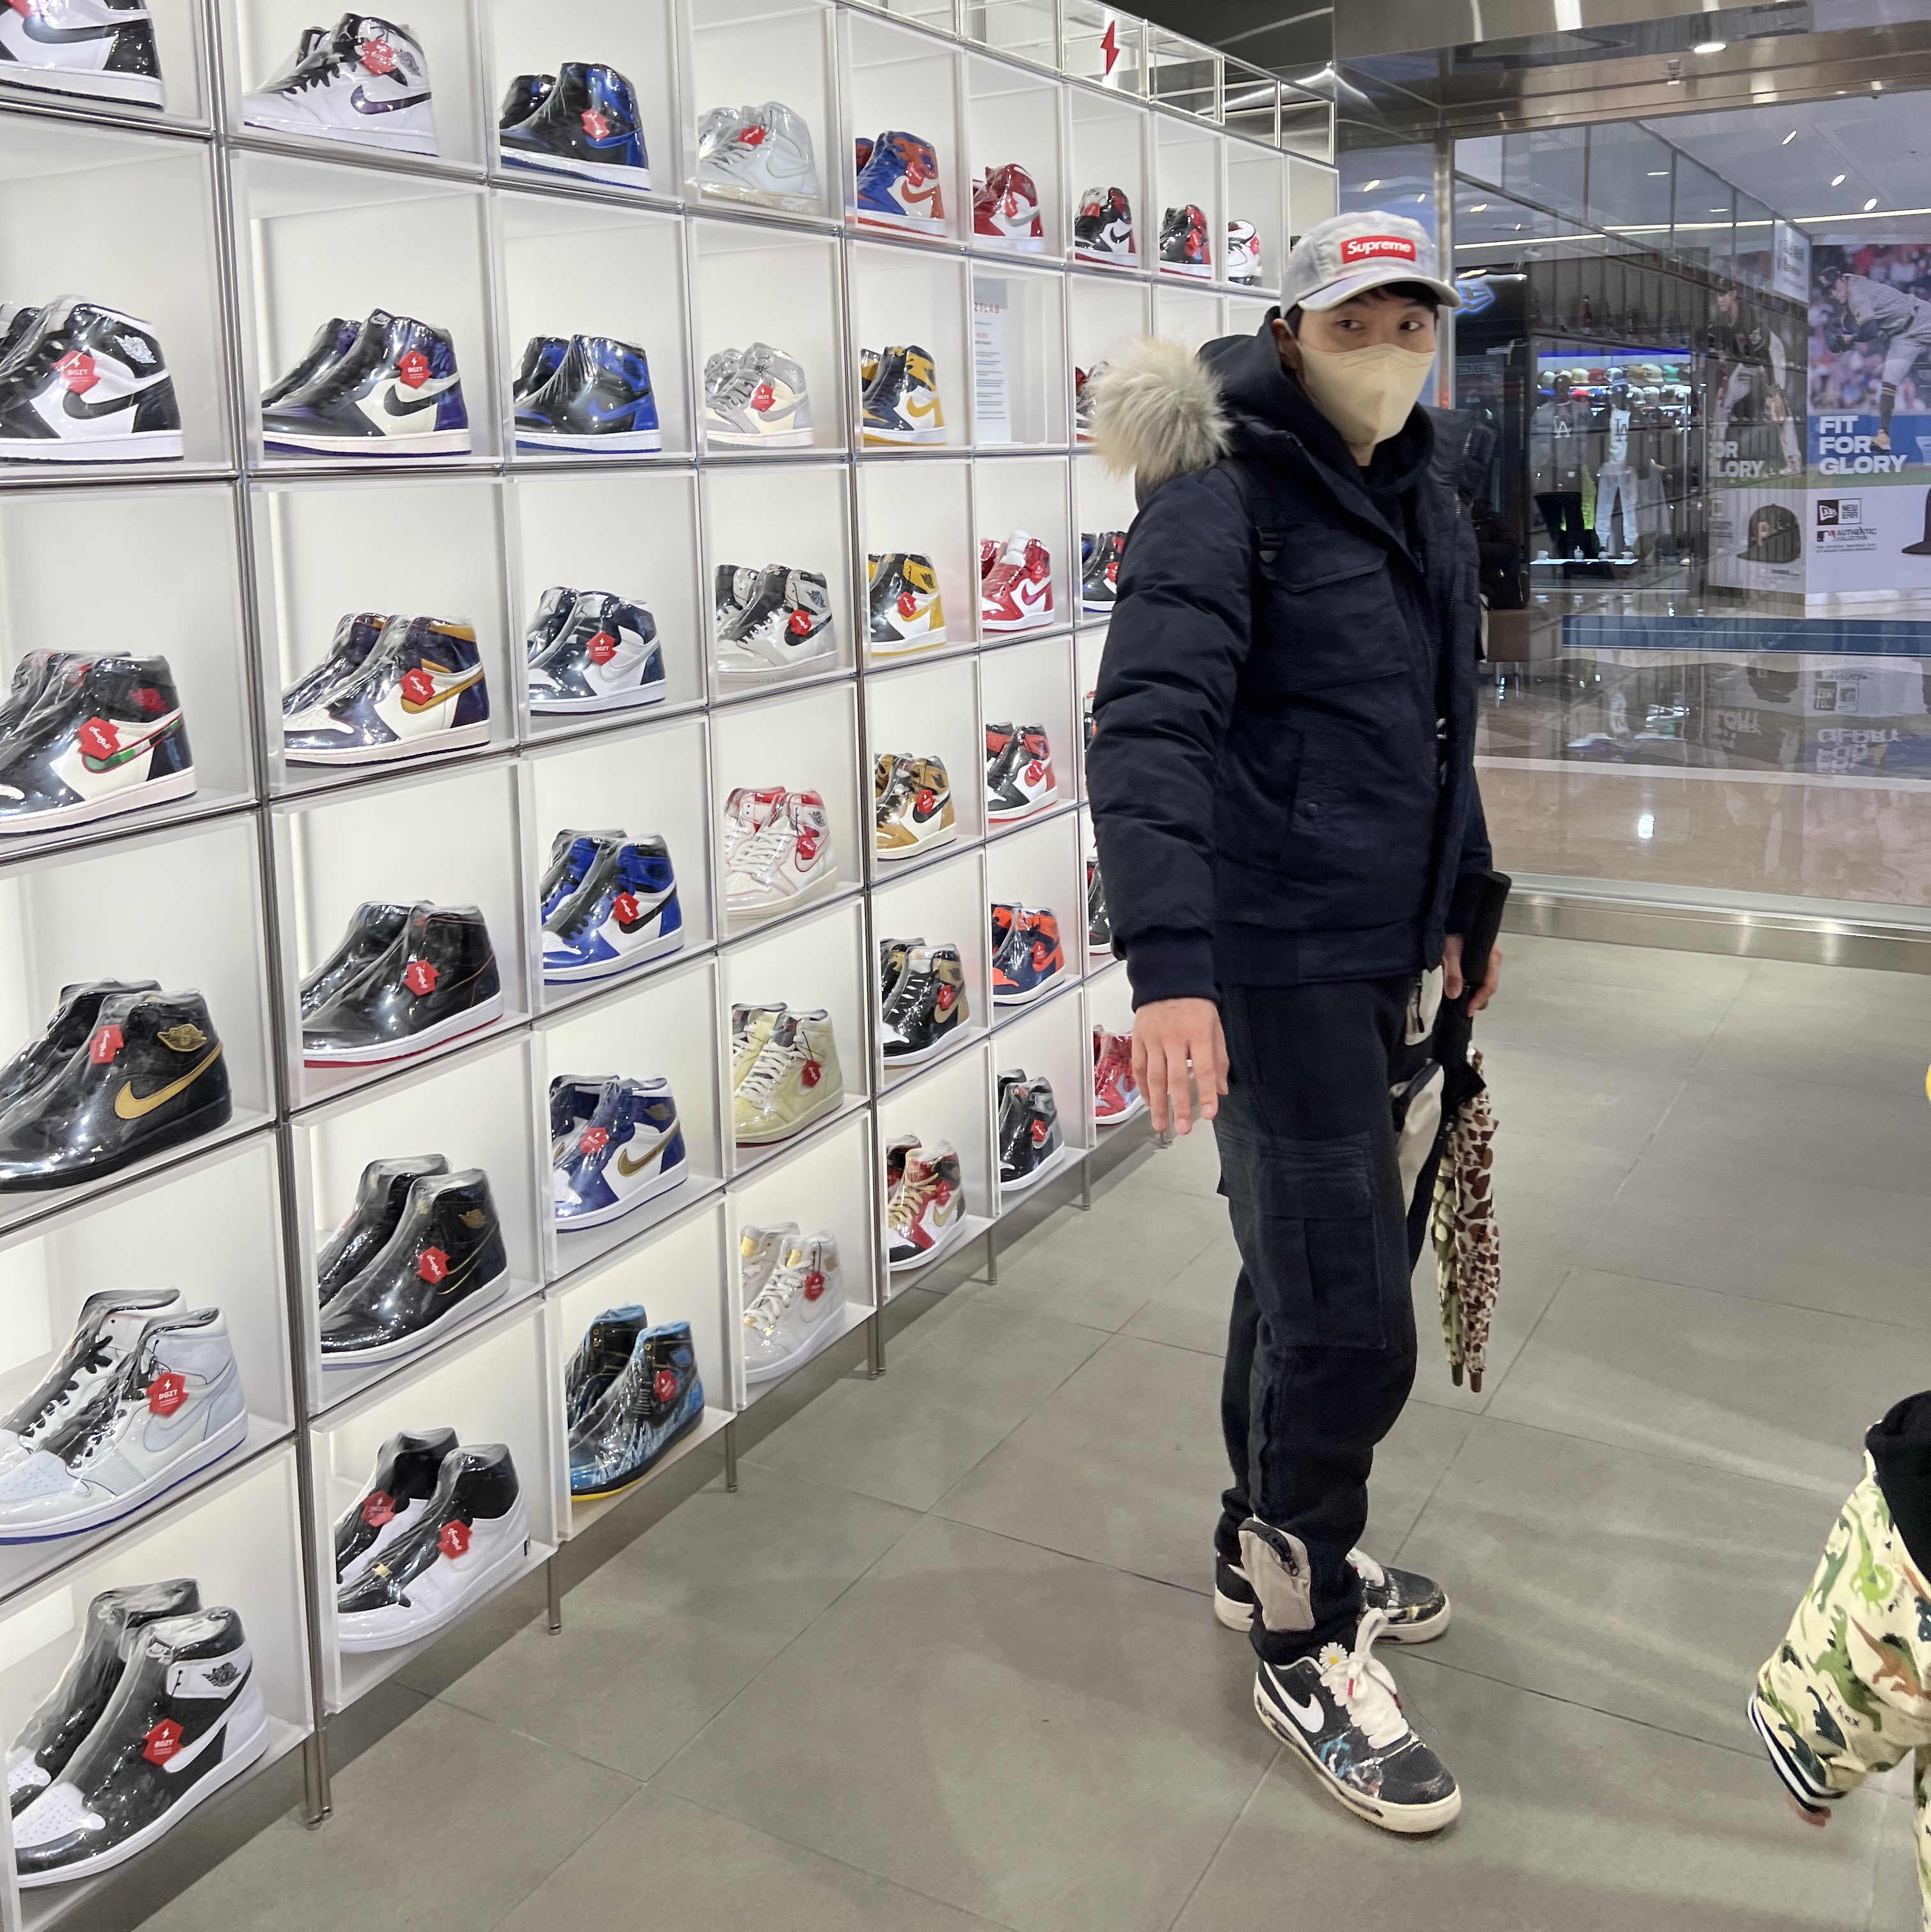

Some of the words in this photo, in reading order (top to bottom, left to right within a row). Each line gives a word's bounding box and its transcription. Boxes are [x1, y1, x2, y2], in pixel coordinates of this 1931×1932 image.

[1347, 240, 1412, 255] Supreme
[1819, 415, 1859, 434] FIT
[1819, 435, 1872, 455] FOR
[1819, 454, 1908, 475] GLORY
[158, 1389, 179, 1400] BGZT
